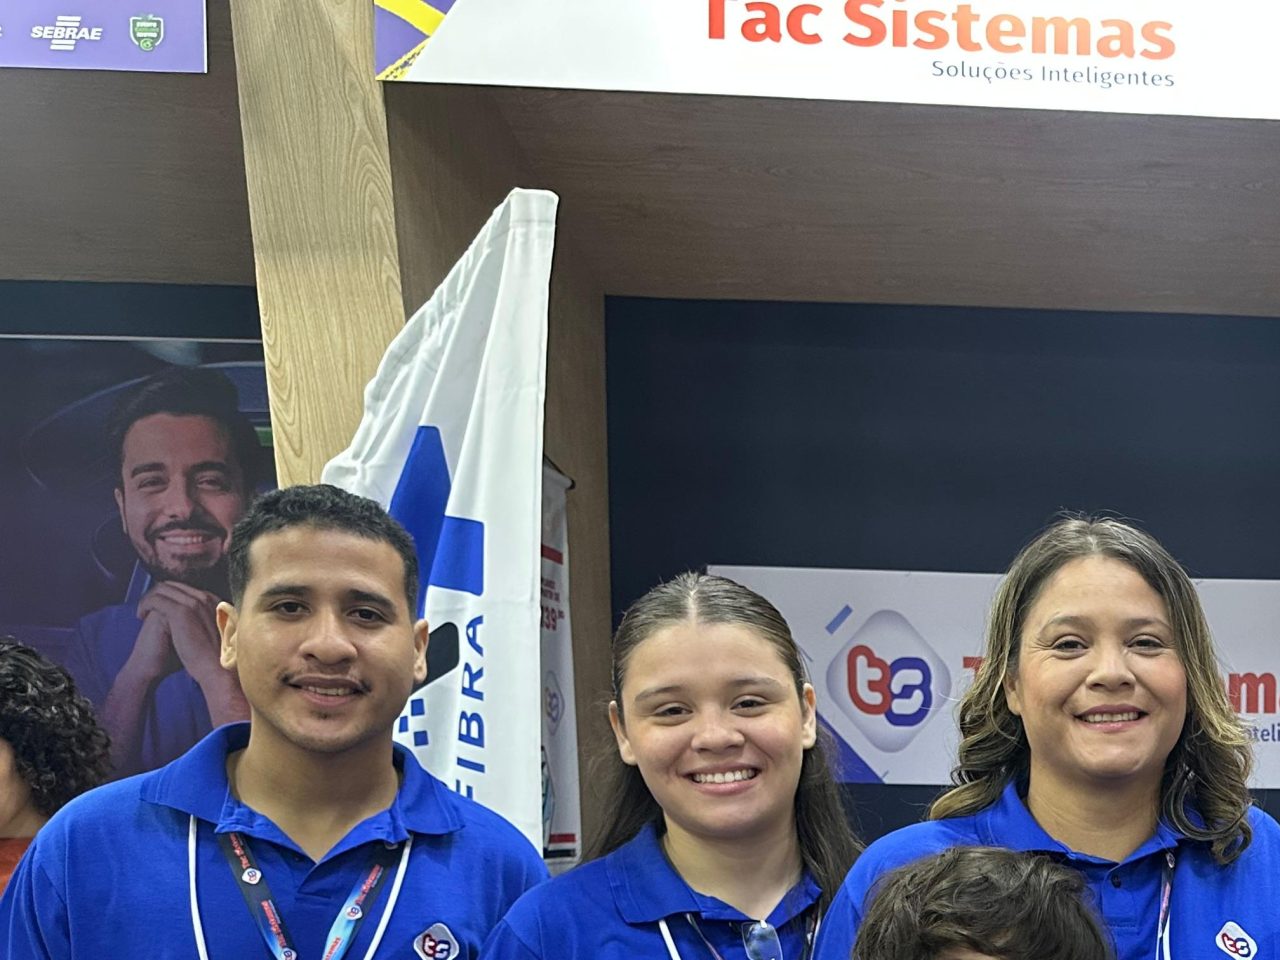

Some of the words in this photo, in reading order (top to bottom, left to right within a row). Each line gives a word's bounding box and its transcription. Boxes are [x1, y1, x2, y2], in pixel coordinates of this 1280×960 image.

[31, 26, 103, 40] SEBRAE
[704, 0, 823, 44] Tac
[842, 0, 1176, 60] Sistemas
[932, 60, 1033, 84] Soluções
[1041, 66, 1175, 89] Inteligentes
